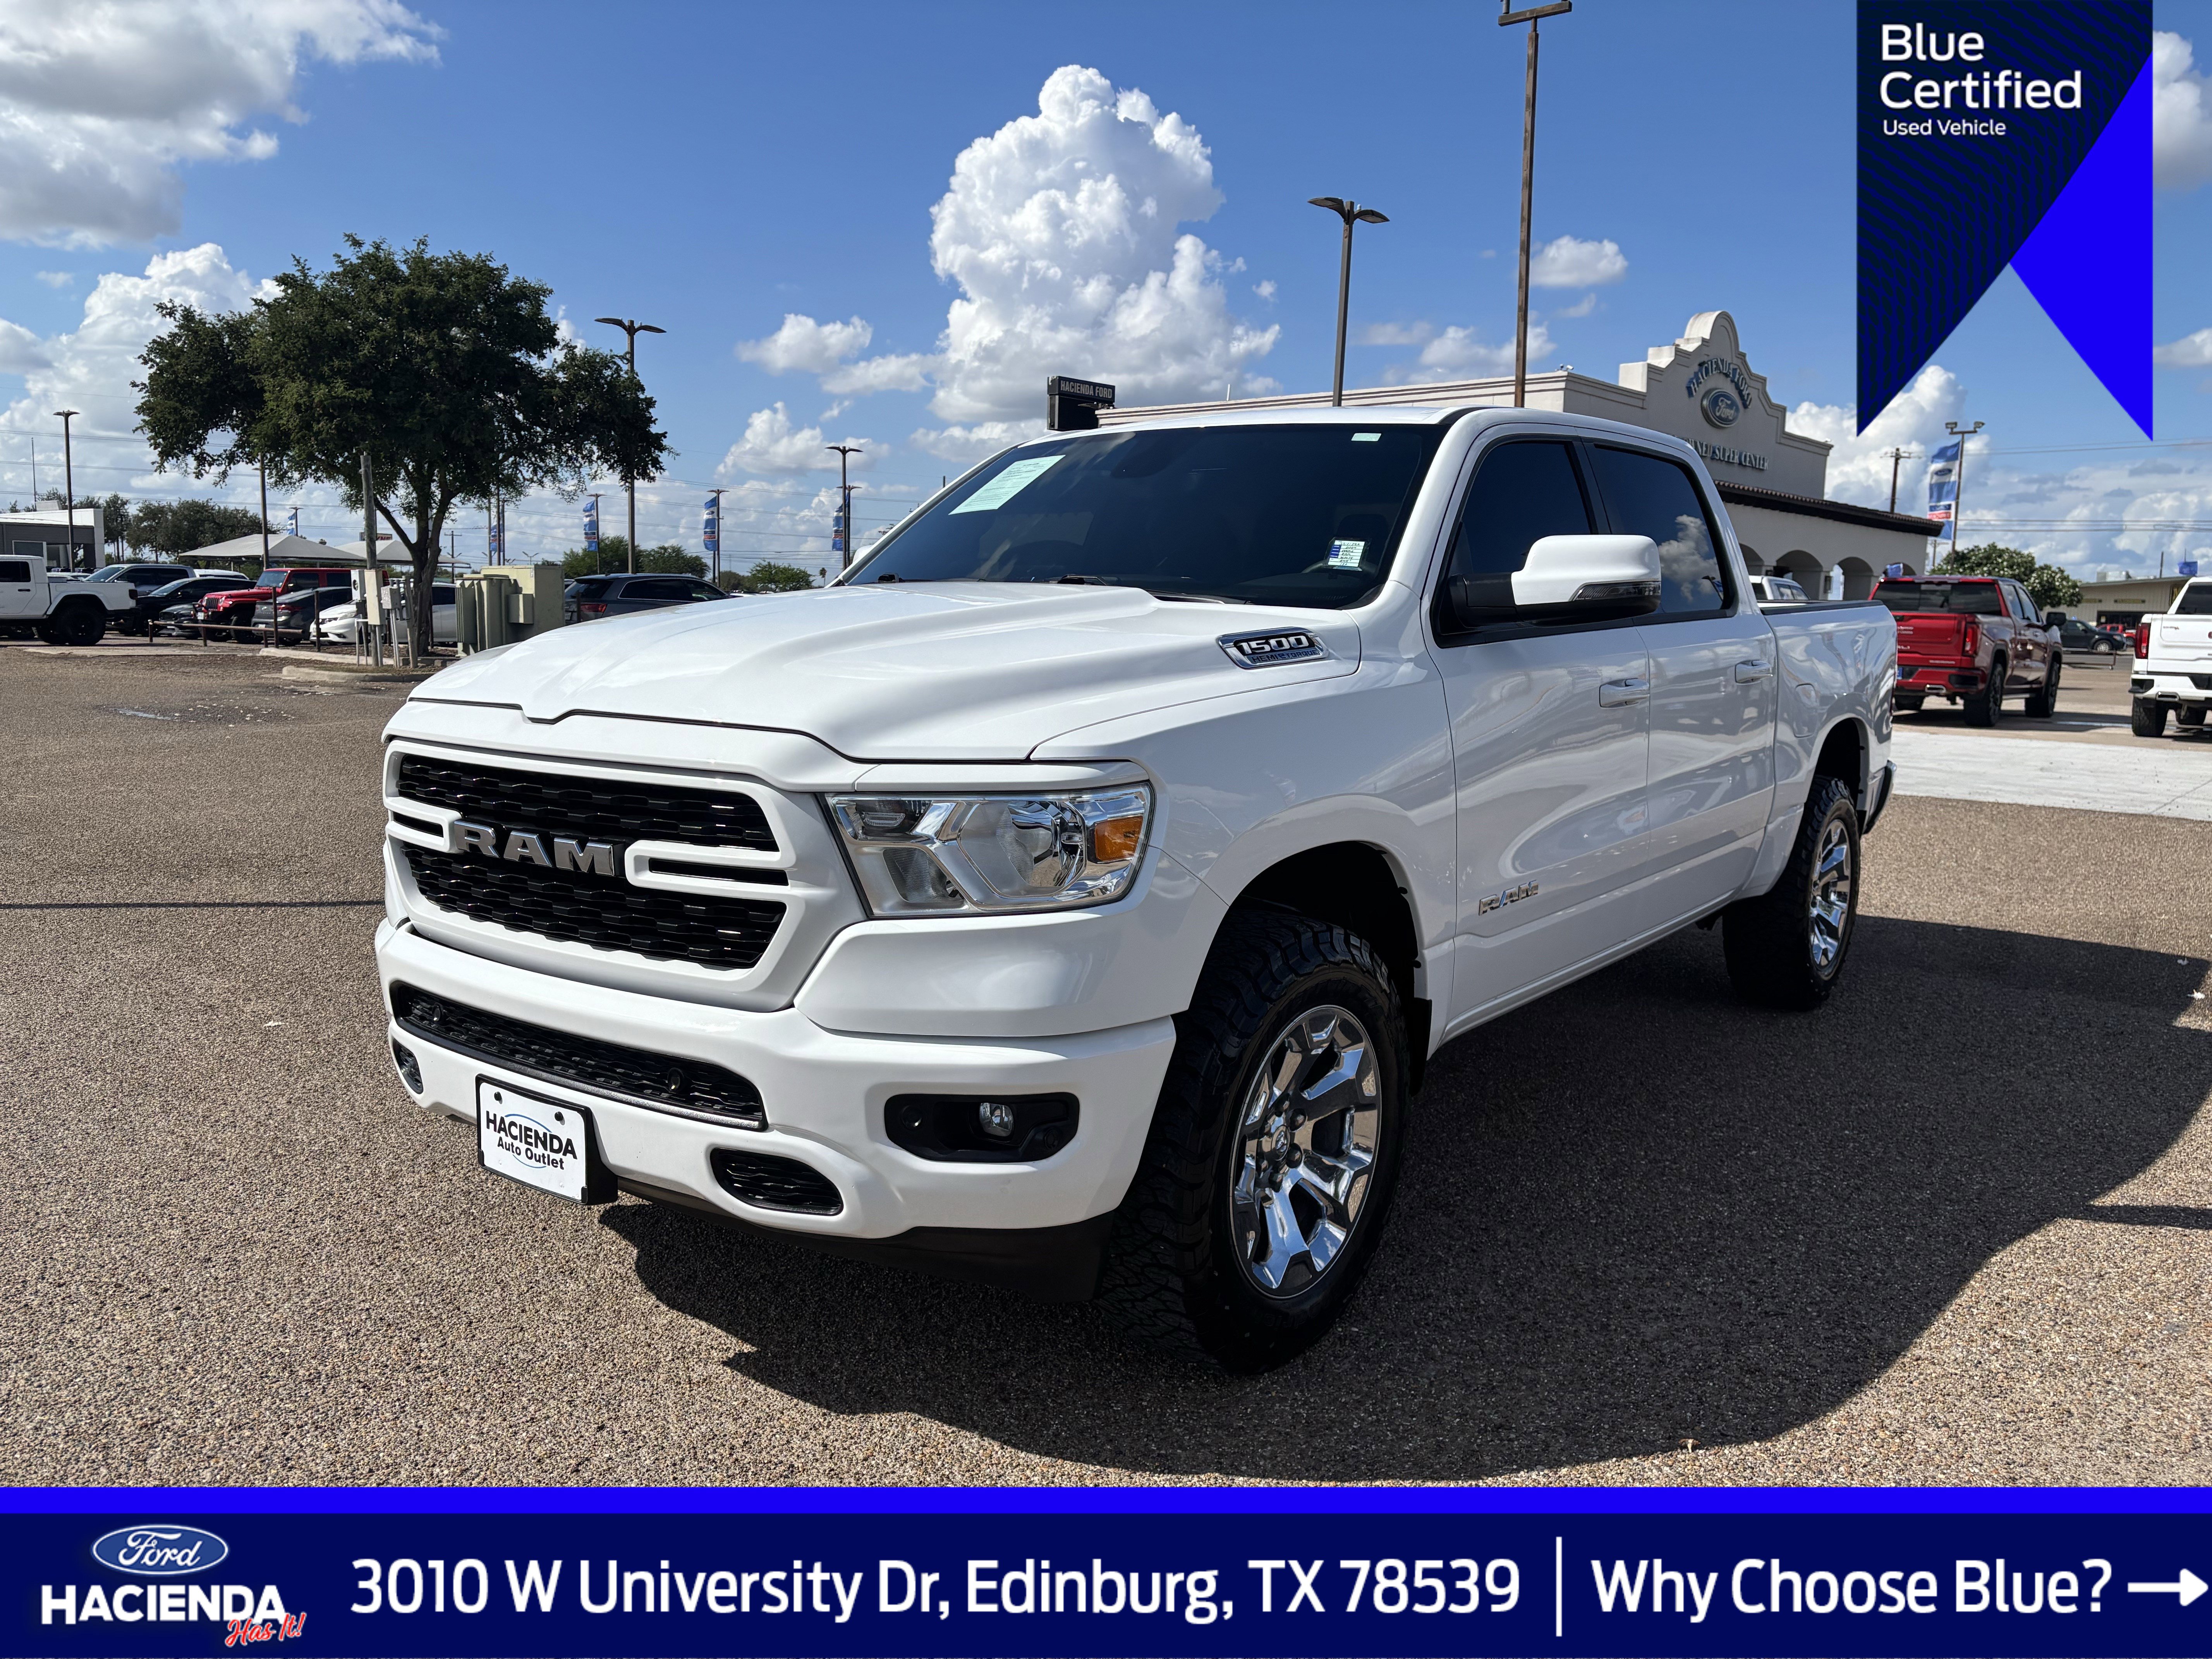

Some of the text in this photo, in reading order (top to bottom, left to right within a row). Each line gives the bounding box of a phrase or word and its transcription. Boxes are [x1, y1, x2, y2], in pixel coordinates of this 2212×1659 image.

[1061, 380, 1113, 398] HACIENDA FORD
[1688, 357, 1733, 396] HACIENDA
[1716, 397, 1736, 420] Ford
[1715, 445, 1739, 464] SUPER
[1742, 452, 1769, 470] CENTER
[1237, 635, 1309, 654] 1500
[1252, 654, 1278, 663] HEMI
[454, 820, 615, 877] RAM
[1479, 880, 1539, 915] RAM
[486, 1110, 578, 1160] HACIENDA
[497, 1136, 565, 1170] Auto Outlet
